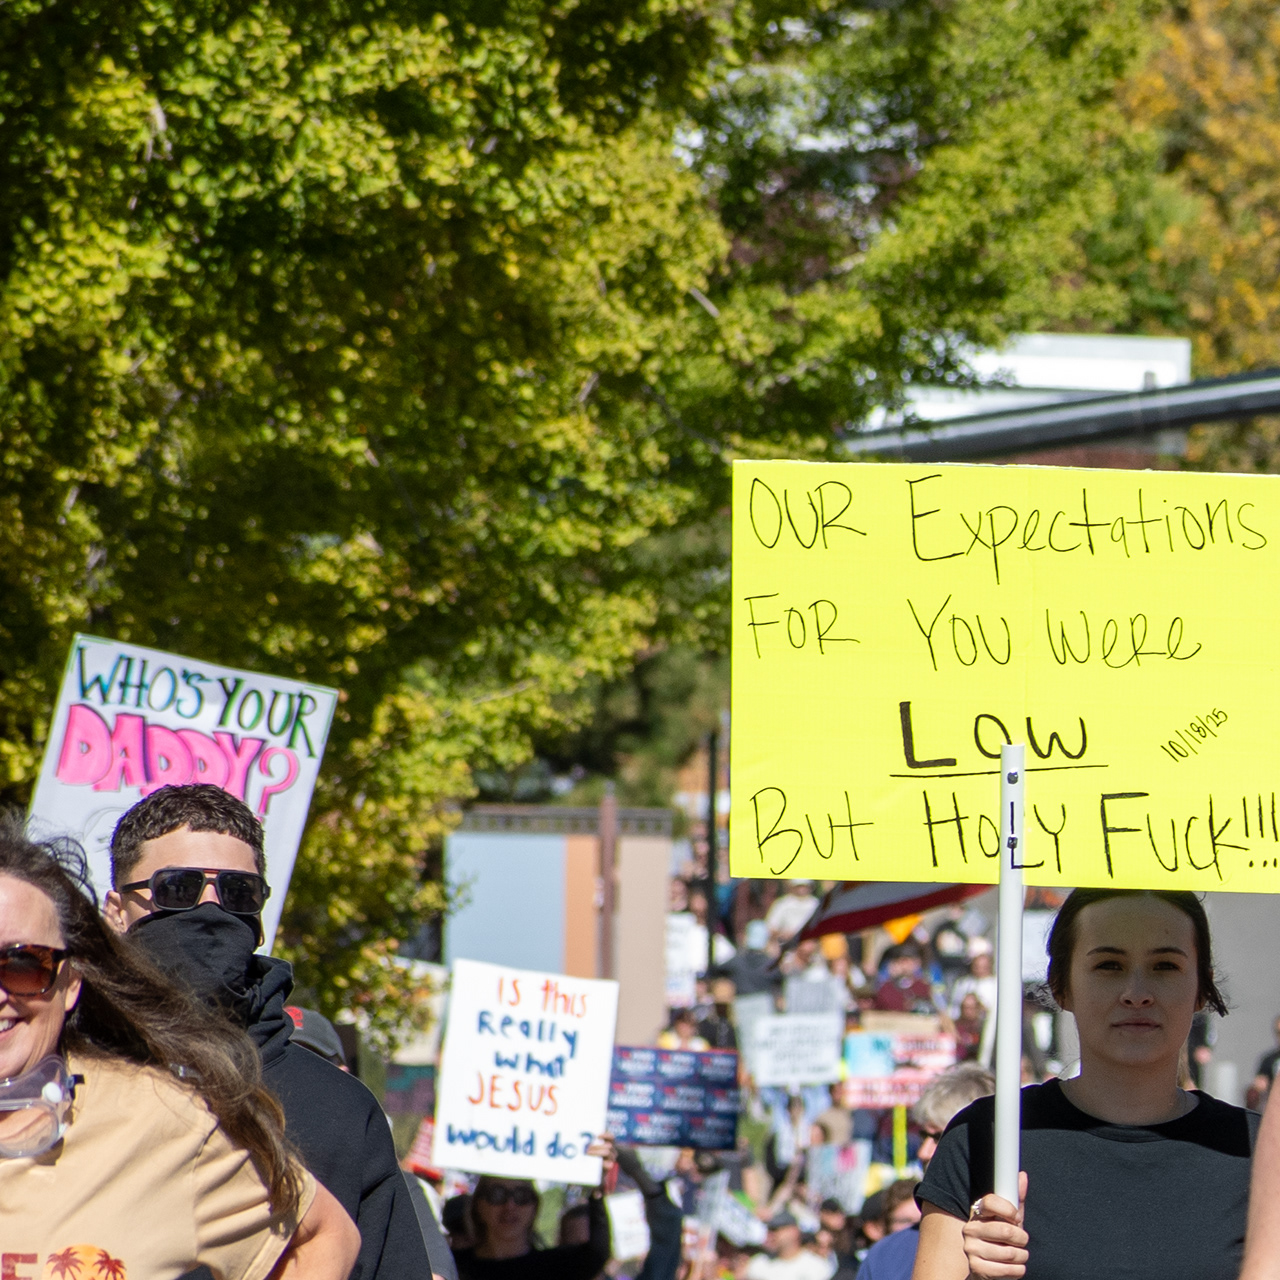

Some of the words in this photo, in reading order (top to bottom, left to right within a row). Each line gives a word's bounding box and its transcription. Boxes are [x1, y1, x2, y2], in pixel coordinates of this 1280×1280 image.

[750, 477, 866, 549] OUR
[906, 474, 1267, 584] Expectations
[745, 593, 860, 658] FOR
[77, 646, 215, 719] WHO'S
[217, 676, 318, 758] YOUR
[1160, 708, 1229, 762] 10/18/25
[55, 703, 299, 822] DADDY?
[467, 1071, 560, 1116] JESUS
